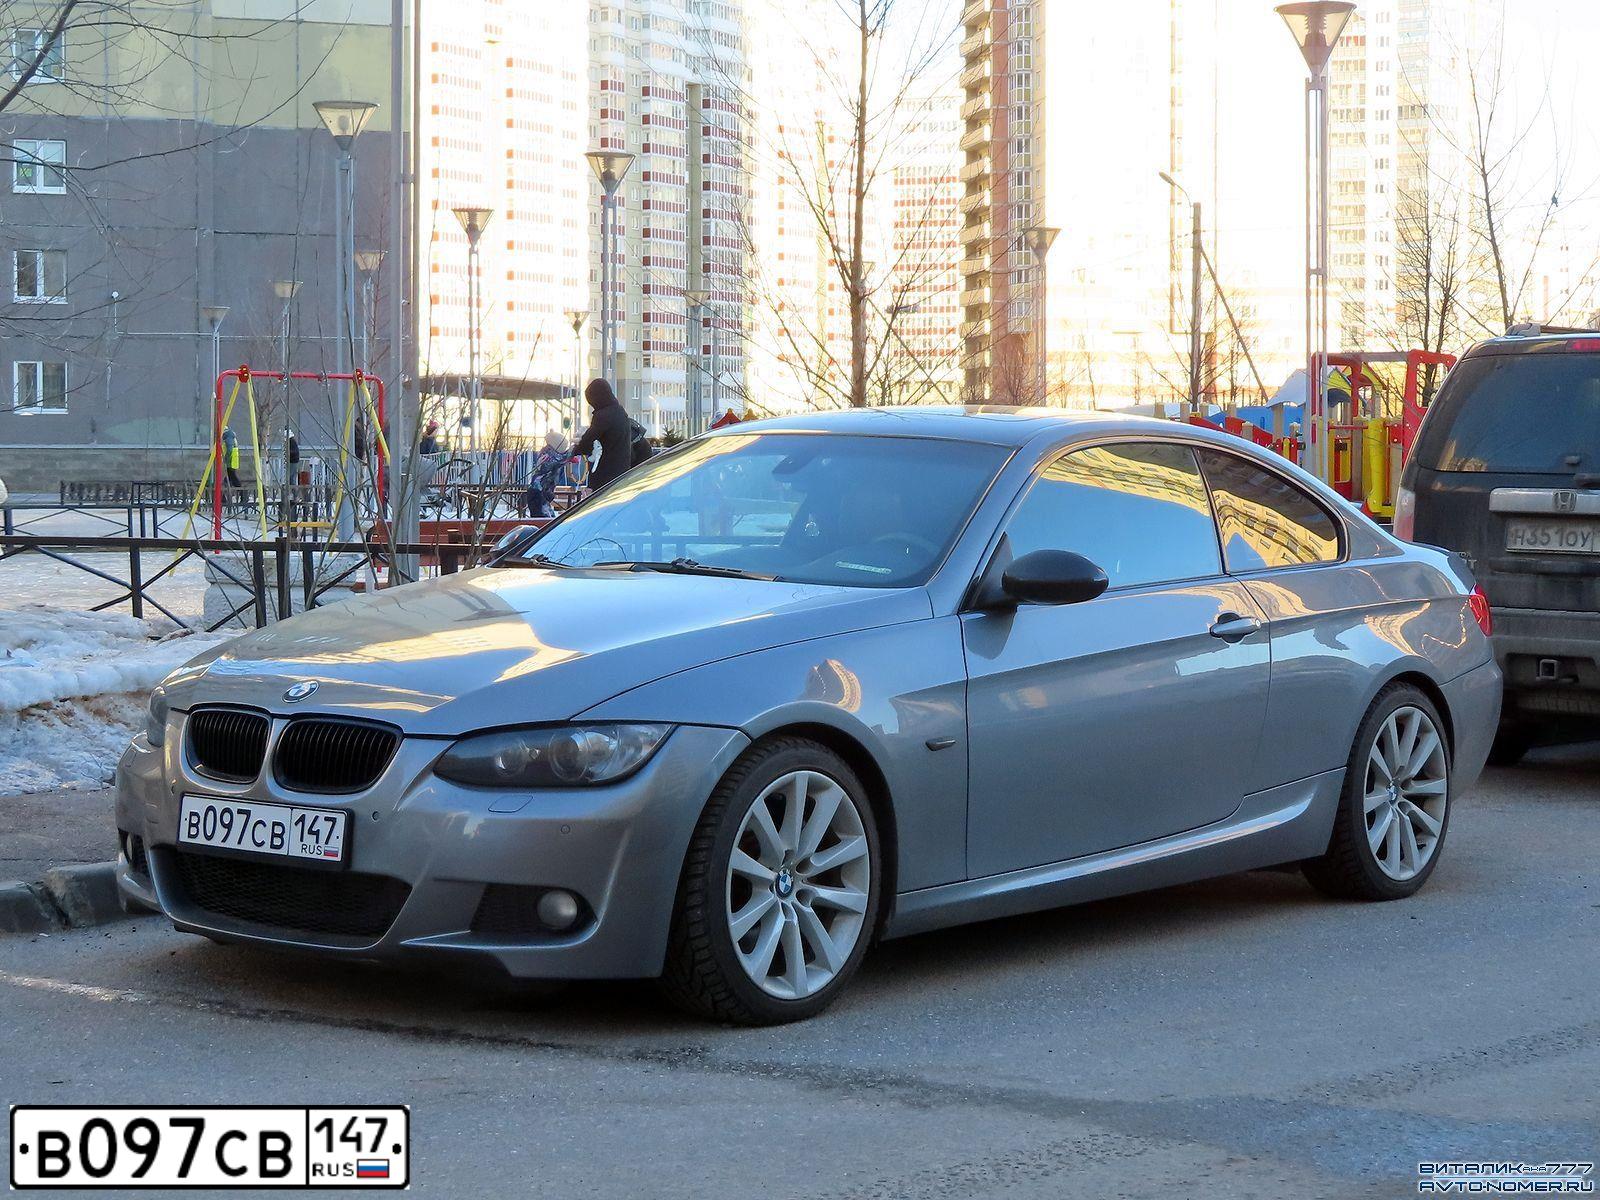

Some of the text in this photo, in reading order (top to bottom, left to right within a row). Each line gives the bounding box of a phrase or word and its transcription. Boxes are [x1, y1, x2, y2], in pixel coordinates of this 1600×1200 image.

[187, 804, 337, 849] В097СВ 147
[301, 843, 323, 856] RUS
